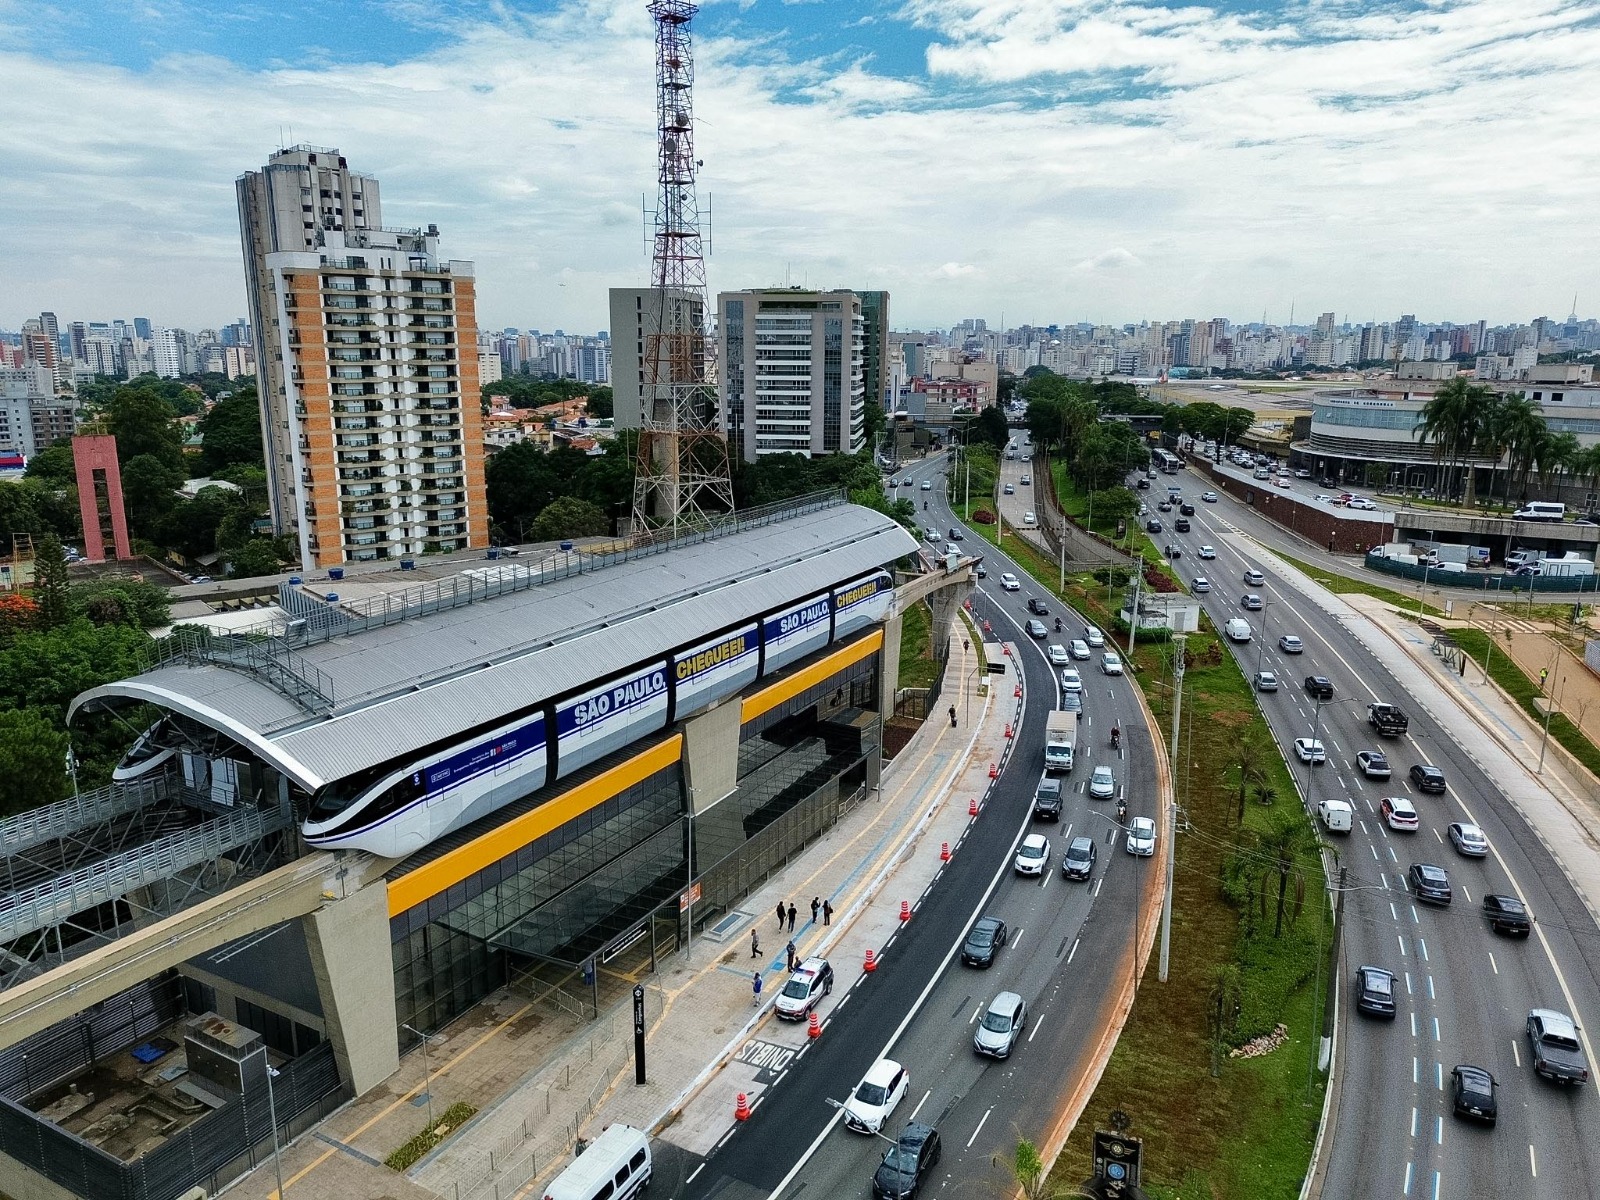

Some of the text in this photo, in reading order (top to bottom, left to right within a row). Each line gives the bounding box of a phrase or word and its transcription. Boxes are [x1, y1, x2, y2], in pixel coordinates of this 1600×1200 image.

[800, 601, 830, 624] PAULO,
[676, 636, 745, 679] CHEGUEEI!
[574, 671, 666, 725] SÃO PAULO,
